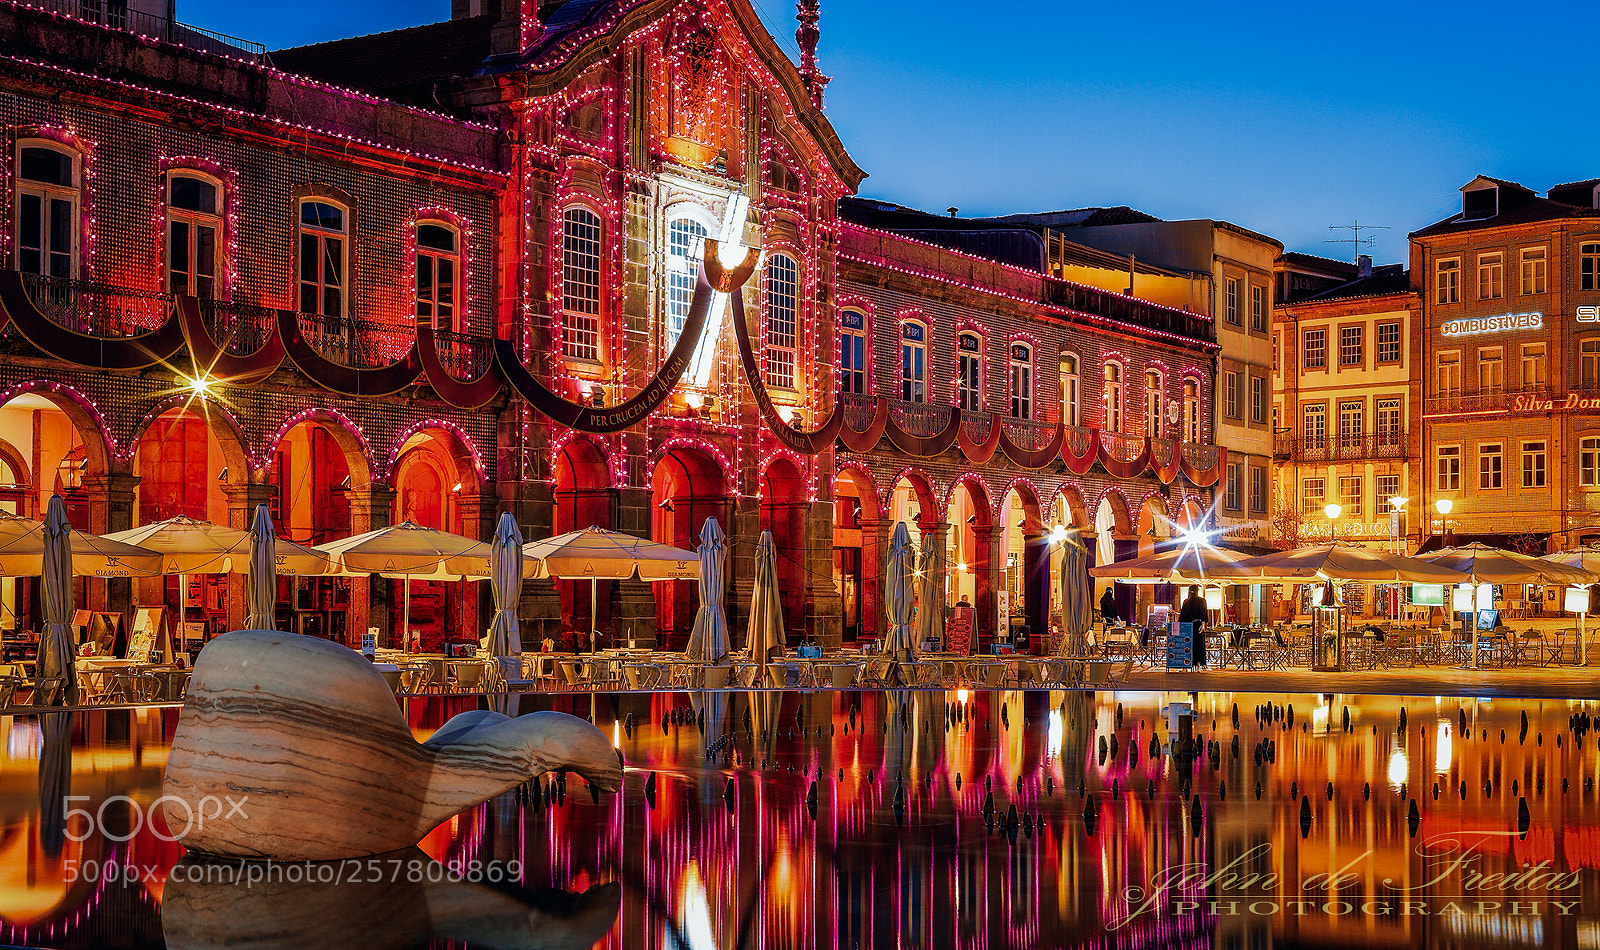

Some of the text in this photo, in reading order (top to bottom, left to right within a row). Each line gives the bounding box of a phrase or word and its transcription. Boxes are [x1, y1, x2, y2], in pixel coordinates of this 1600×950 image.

[850, 315, 860, 326] BPI
[1440, 312, 1541, 336] COMBUSTÍVEIS
[910, 327, 920, 338] BPI
[966, 338, 976, 349] BPI
[590, 356, 684, 426] PER CRUCEM AD LUCEM
[1514, 395, 1553, 411] Silva
